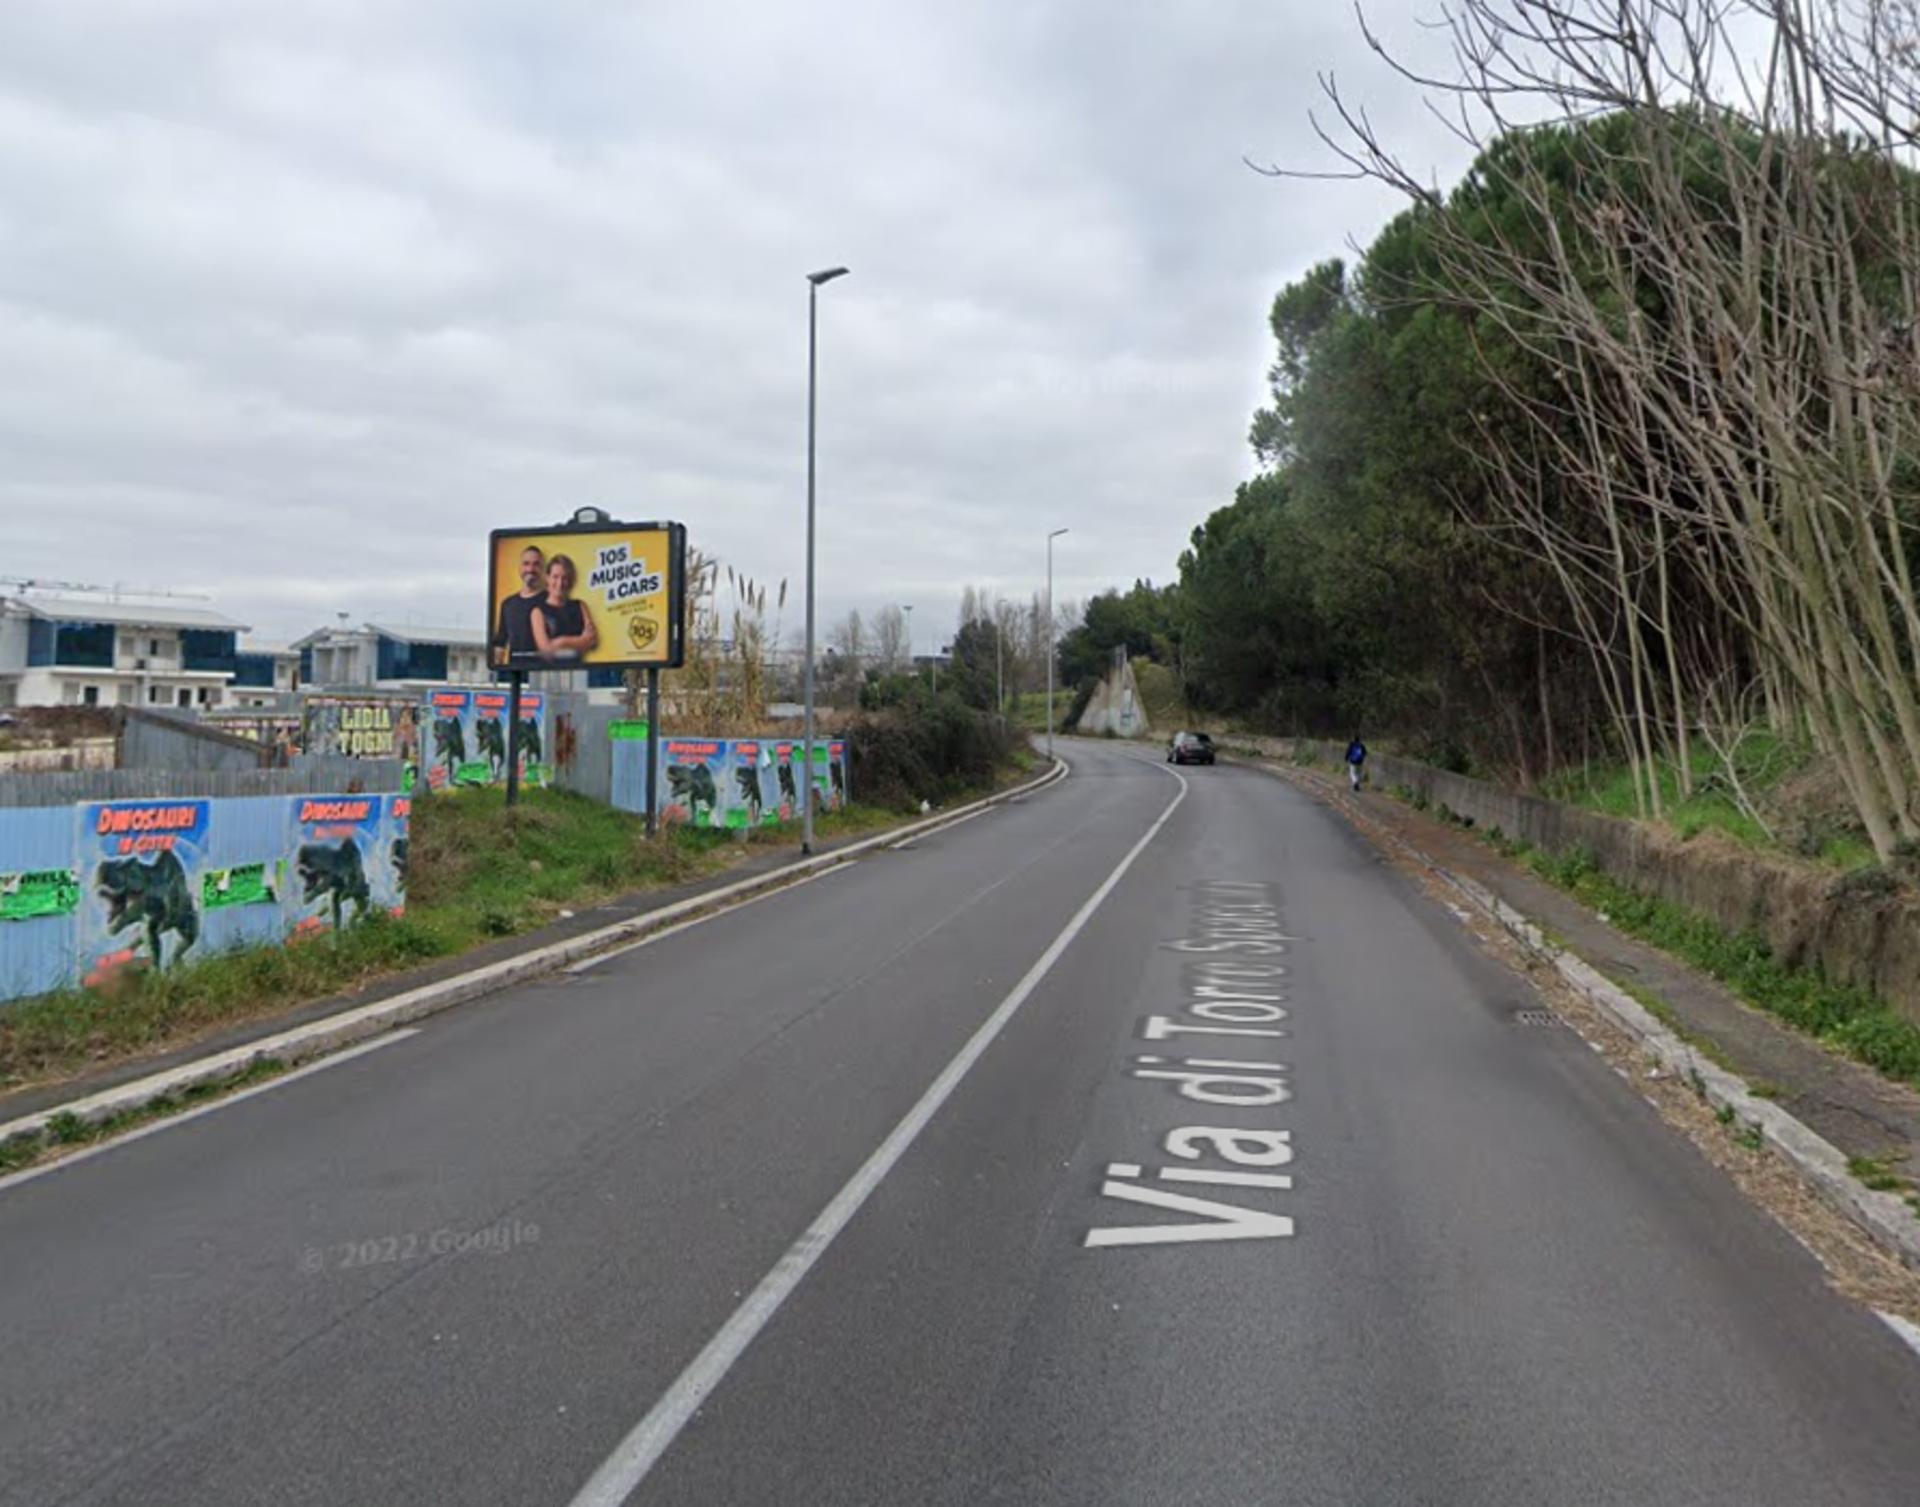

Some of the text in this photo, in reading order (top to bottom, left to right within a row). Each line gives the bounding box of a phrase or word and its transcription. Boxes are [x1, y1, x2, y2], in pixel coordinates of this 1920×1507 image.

[600, 547, 627, 566] 105
[590, 562, 642, 587] MUSIC
[617, 575, 659, 598] CARS
